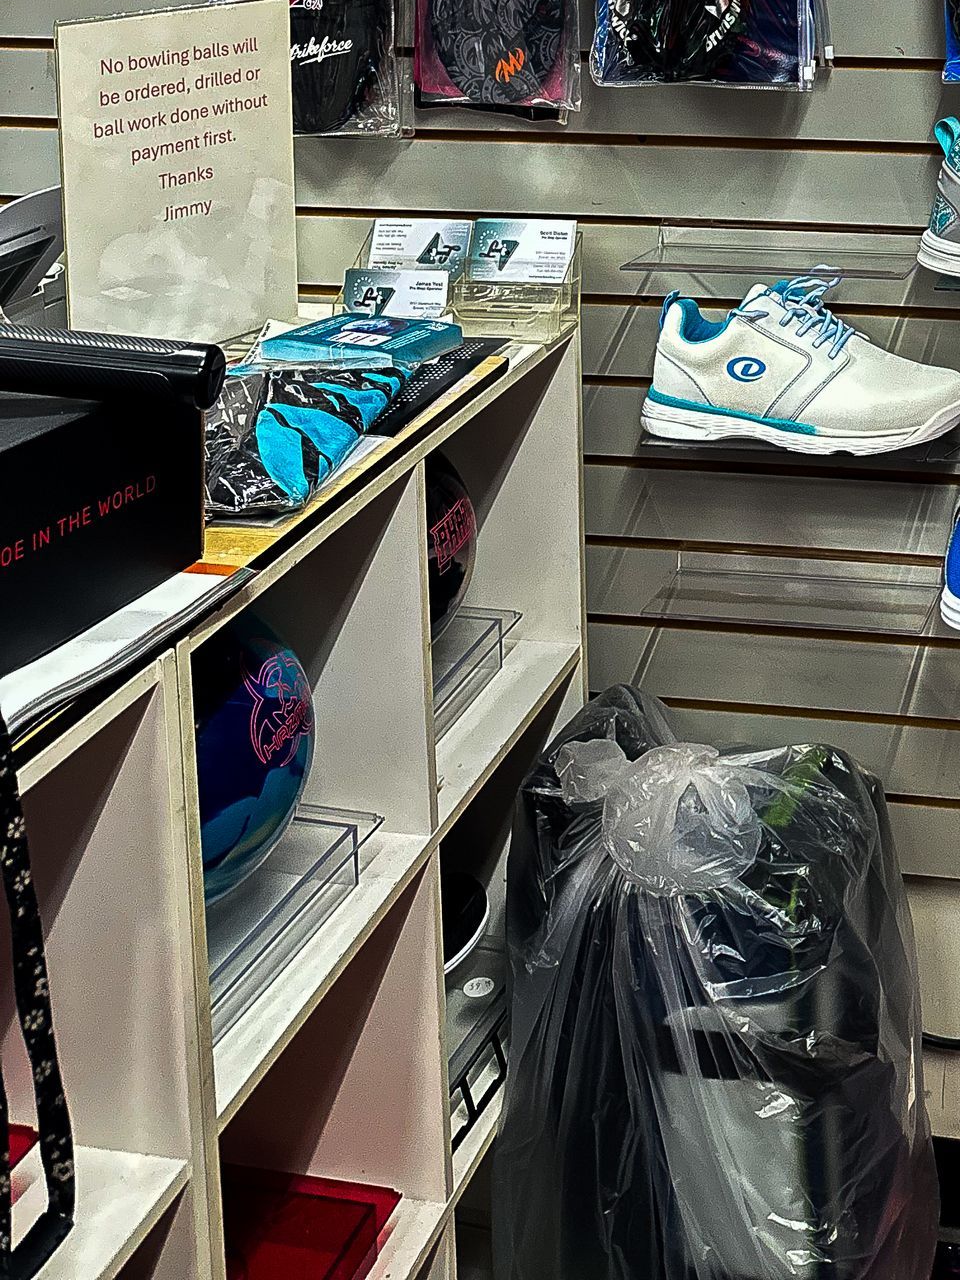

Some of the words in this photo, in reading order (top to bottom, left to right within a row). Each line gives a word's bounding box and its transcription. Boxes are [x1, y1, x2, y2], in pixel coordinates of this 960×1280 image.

[100, 58, 123, 75] No
[128, 50, 189, 71] bowling
[193, 43, 229, 60] balls
[233, 37, 258, 54] will
[290, 36, 353, 62] trikeforce
[100, 91, 120, 106] be
[125, 77, 190, 102] ordered,
[195, 68, 241, 89] drilled
[246, 68, 260, 81] or
[94, 119, 124, 138] ball
[128, 112, 166, 131] work
[170, 108, 208, 124] done
[212, 94, 268, 115] without
[131, 135, 200, 165] payment
[203, 129, 236, 147] first.
[158, 166, 213, 189] Thanks
[163, 200, 212, 222] Jimmy
[32, 527, 50, 551] IN
[57, 505, 91, 537] THE
[98, 475, 156, 516] WORLD
